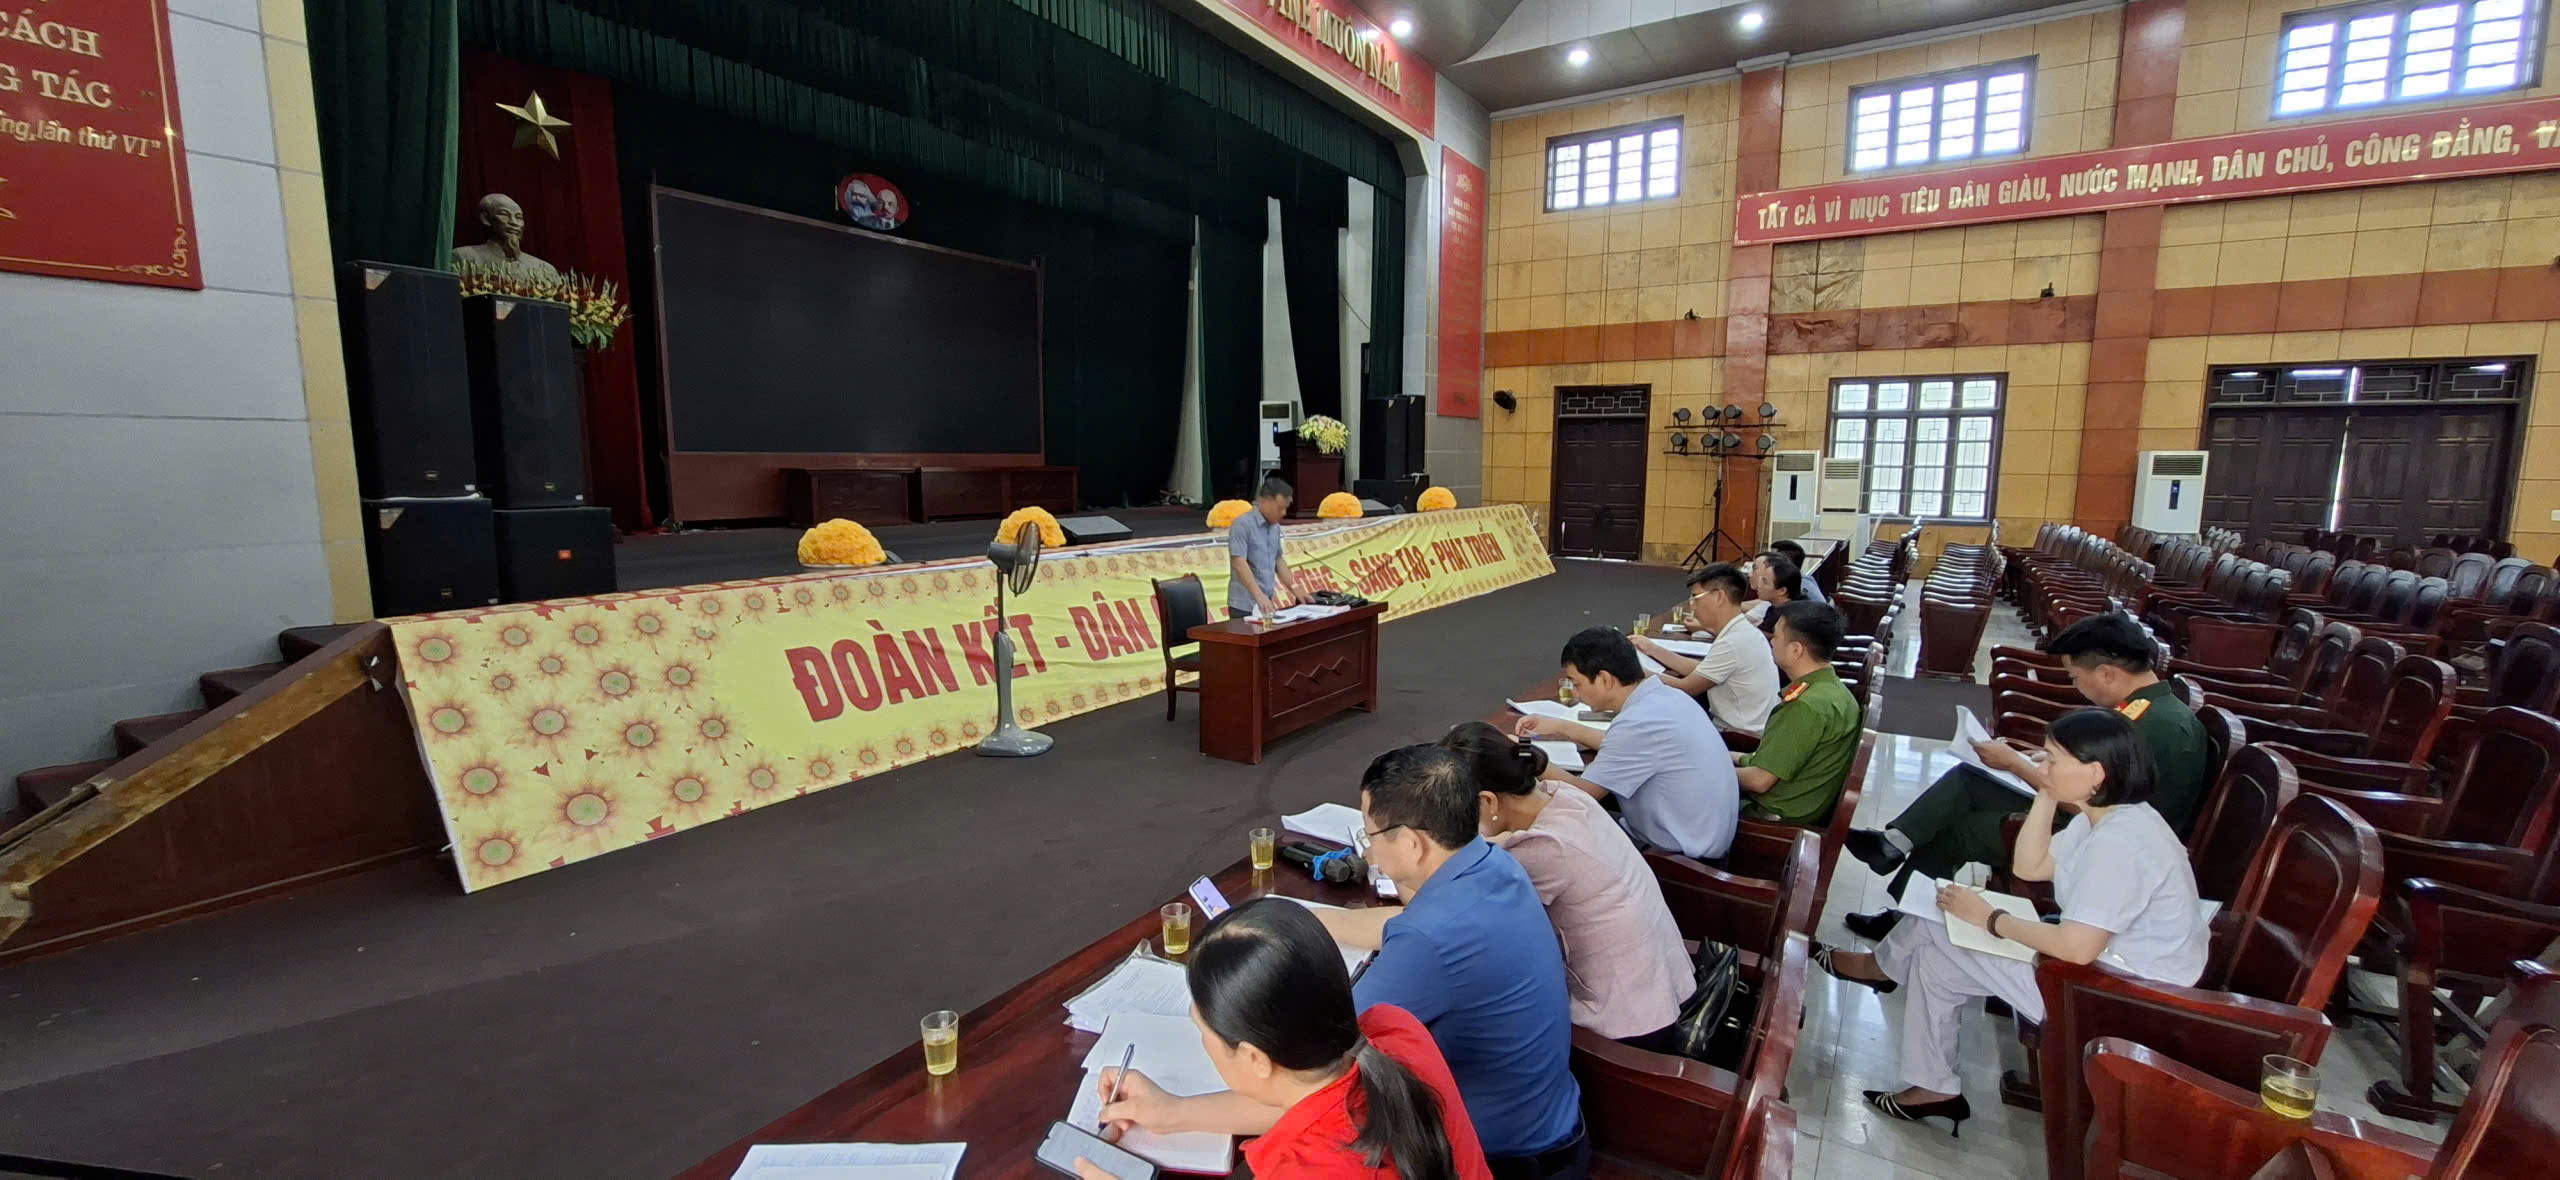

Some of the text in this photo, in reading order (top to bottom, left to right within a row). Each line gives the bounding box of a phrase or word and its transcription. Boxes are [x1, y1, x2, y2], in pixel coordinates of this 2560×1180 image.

[32, 69, 112, 108] TÁC
[79, 126, 117, 150] thứ
[1758, 200, 1788, 230] TẤT
[1794, 195, 1817, 226] CẢ
[1824, 195, 1841, 223] VÌ
[1850, 194, 1891, 223] MỤC
[1900, 186, 1941, 215] TIÊU
[1949, 180, 1991, 210] DÂN
[1998, 173, 2051, 203] GIÀU,
[2059, 163, 2119, 198] NƯỚC
[2126, 159, 2204, 193] MẠNH,
[2211, 149, 2265, 182] DÂN
[2275, 134, 2334, 174] CHỦ,
[2345, 132, 2421, 167] CÔNG
[784, 619, 960, 722] ĐOÀN
[1068, 591, 1158, 661] DÂN
[1349, 549, 1404, 596] SÁNG
[1395, 545, 1431, 589] TẠO
[1432, 531, 1472, 574] PHÁT
[1463, 520, 1506, 567] TRIỂN
